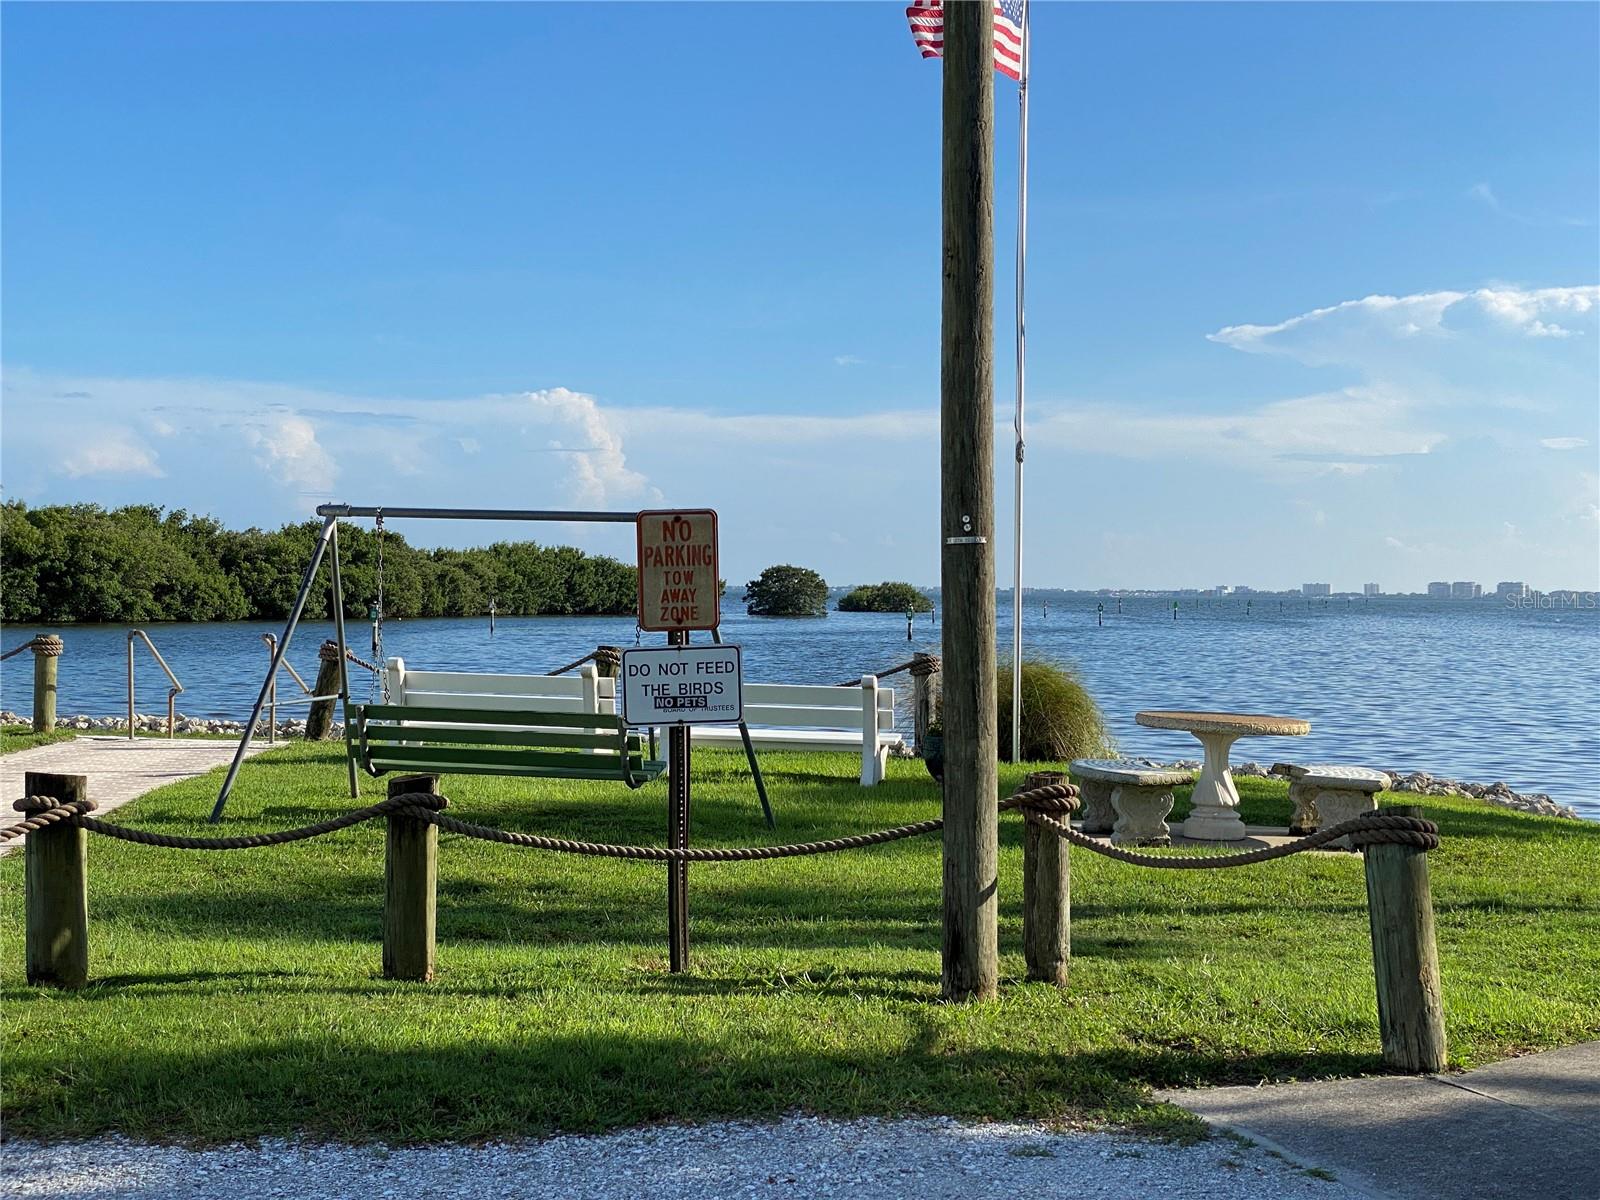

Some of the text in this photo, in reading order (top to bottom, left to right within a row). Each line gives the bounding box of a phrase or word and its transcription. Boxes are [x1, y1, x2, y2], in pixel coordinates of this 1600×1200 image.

[662, 520, 692, 542] NO
[644, 544, 712, 567] PARKING
[663, 570, 694, 585] TOW
[660, 588, 697, 604] AWAY
[660, 606, 699, 622] ZONE
[629, 661, 735, 677] DO NOT FEED
[641, 681, 724, 696] THE BIRDS
[656, 697, 706, 707] NO PETS
